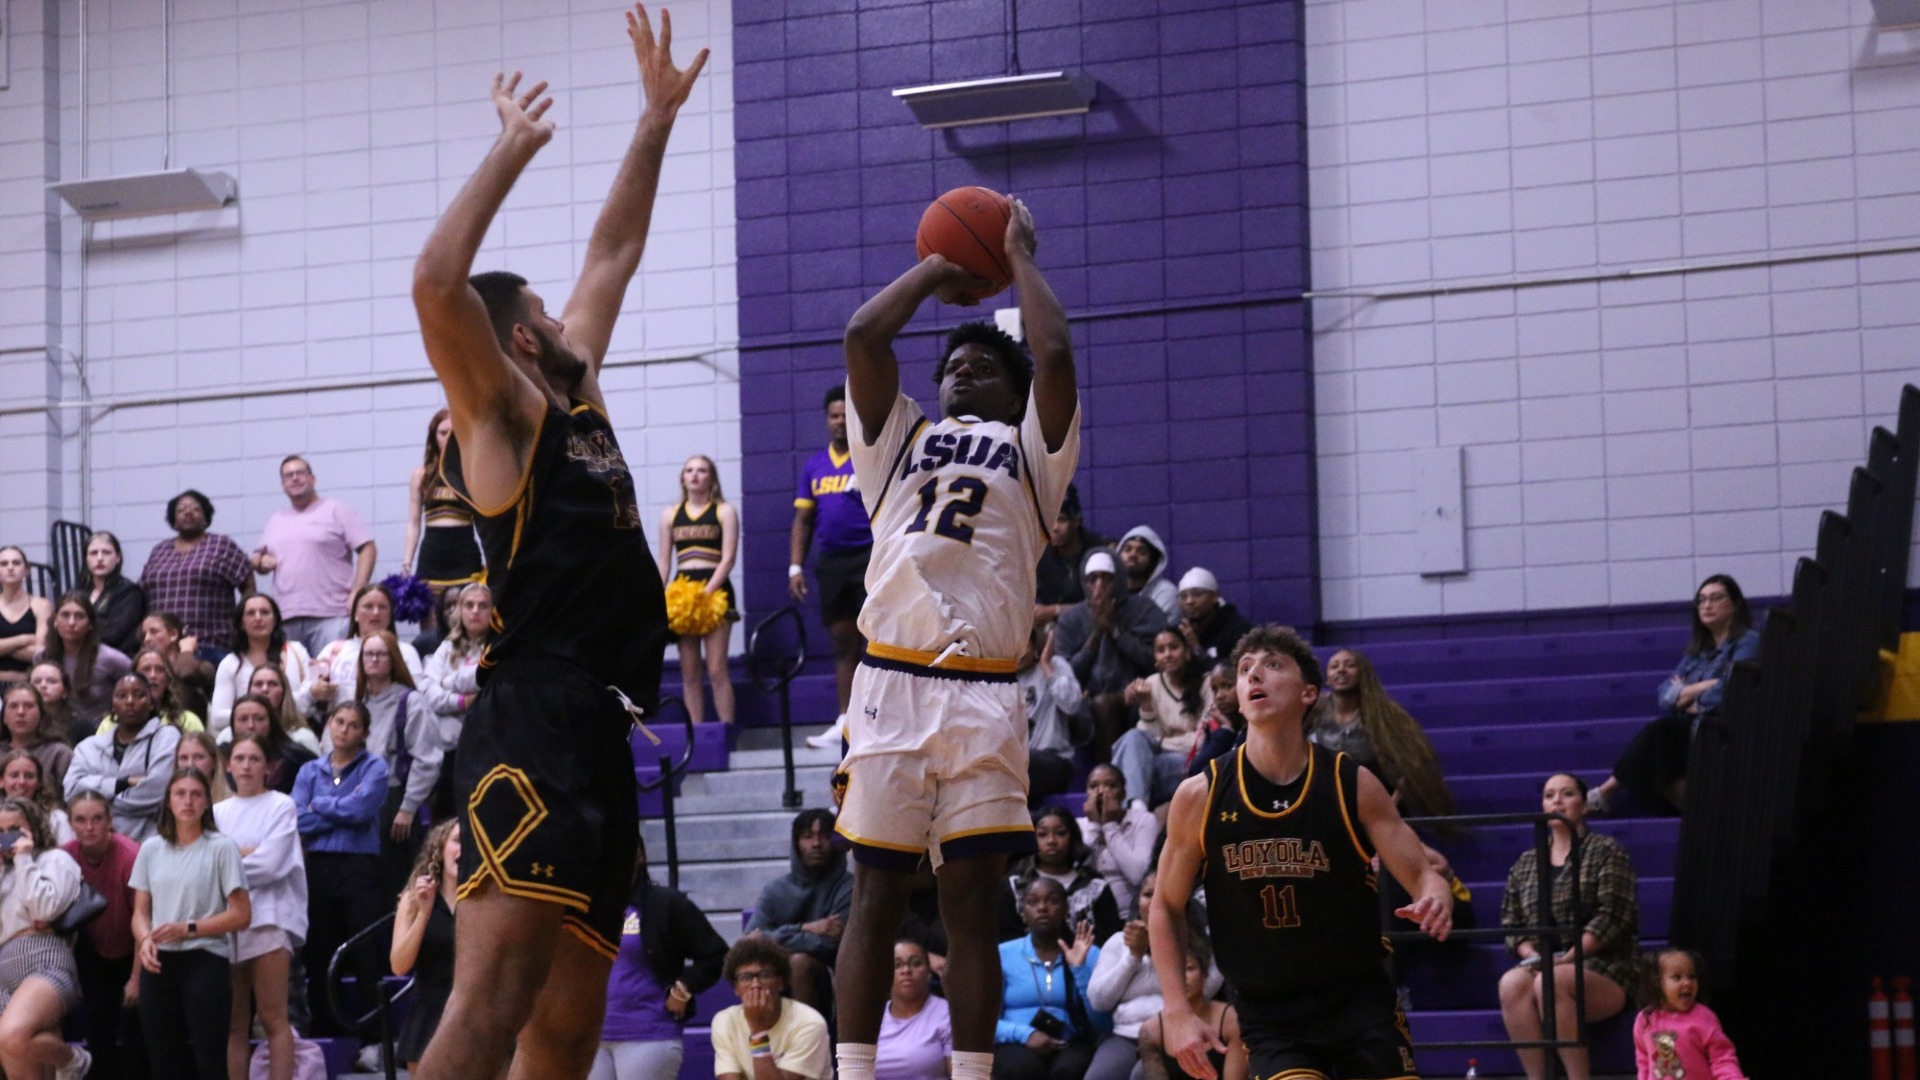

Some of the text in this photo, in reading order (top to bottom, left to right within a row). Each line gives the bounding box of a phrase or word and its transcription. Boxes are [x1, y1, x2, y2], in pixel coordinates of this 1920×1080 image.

[900, 433, 1019, 481] LSUA
[902, 475, 989, 547] 12
[1222, 837, 1330, 872] LOYOLA
[1260, 884, 1301, 929] 11
